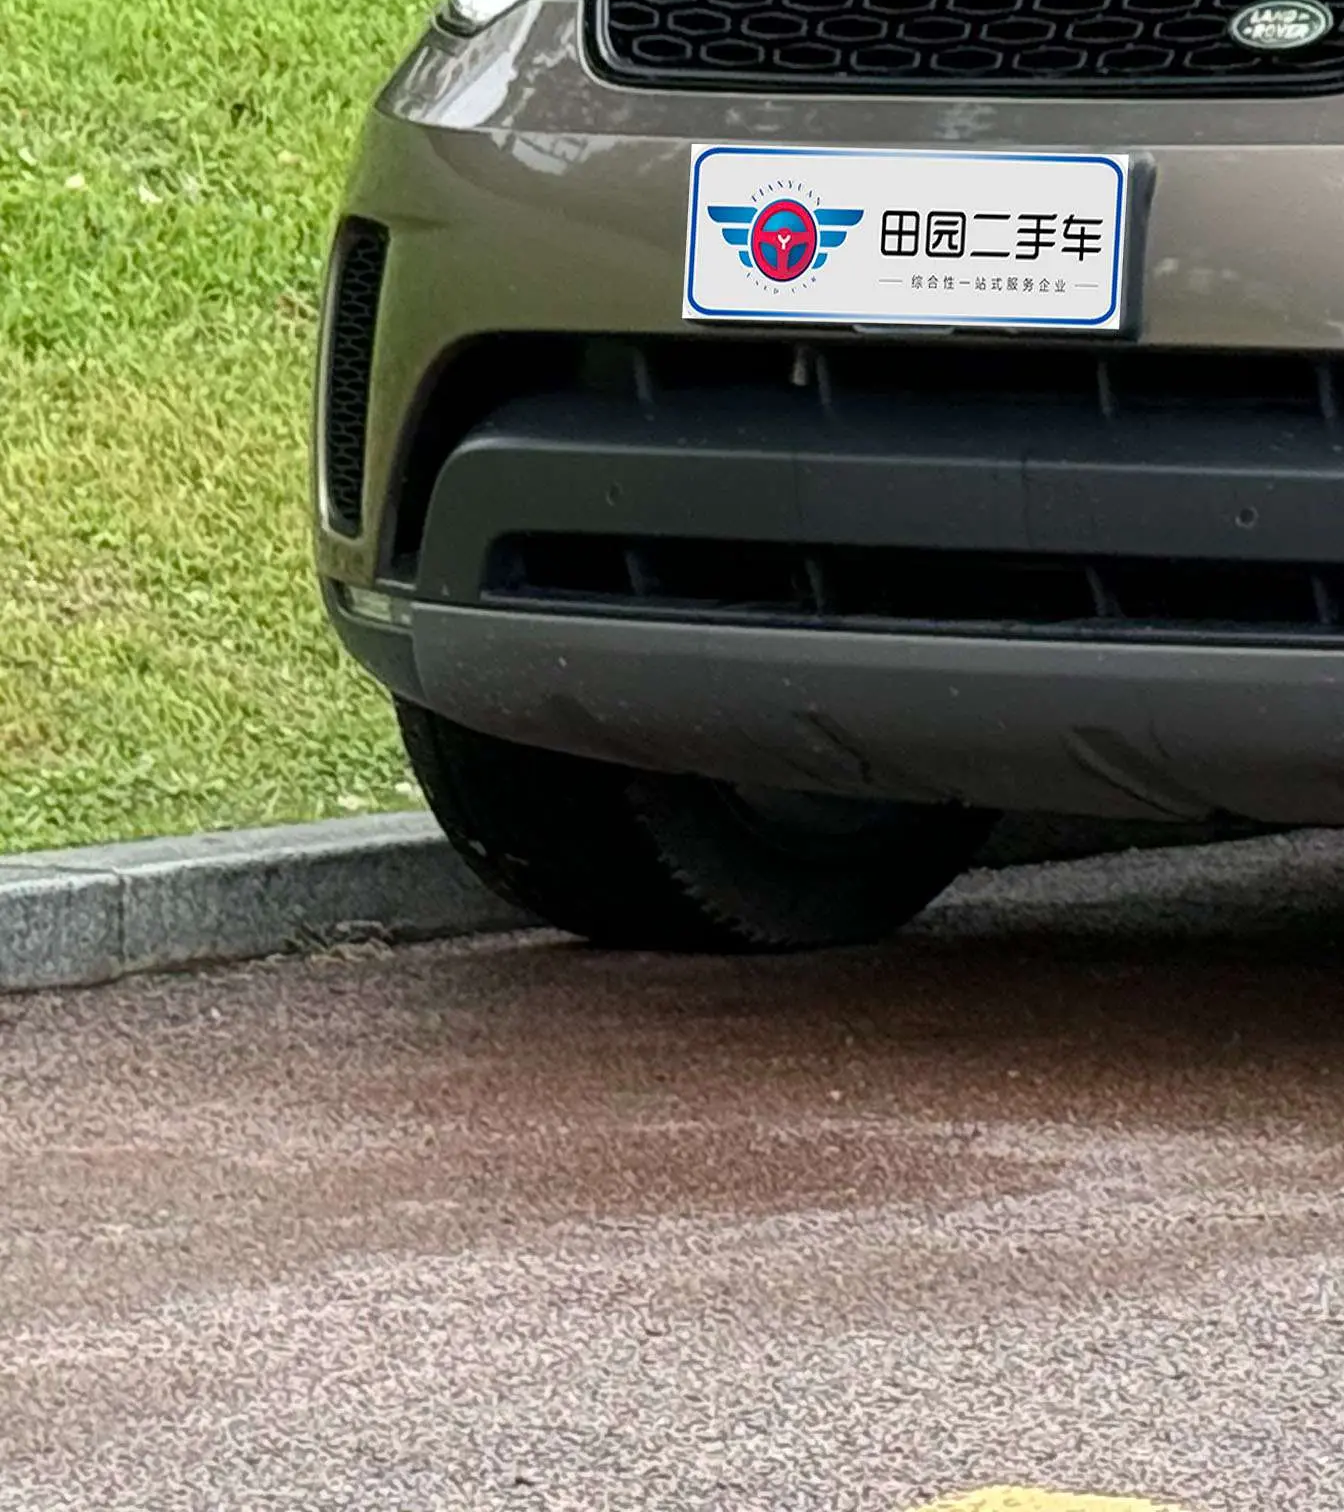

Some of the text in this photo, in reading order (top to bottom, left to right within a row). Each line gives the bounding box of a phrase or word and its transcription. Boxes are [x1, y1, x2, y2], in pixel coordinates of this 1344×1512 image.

[881, 209, 1104, 262] 田园二手车
[910, 273, 1067, 293] 综合性一站式服务企业
